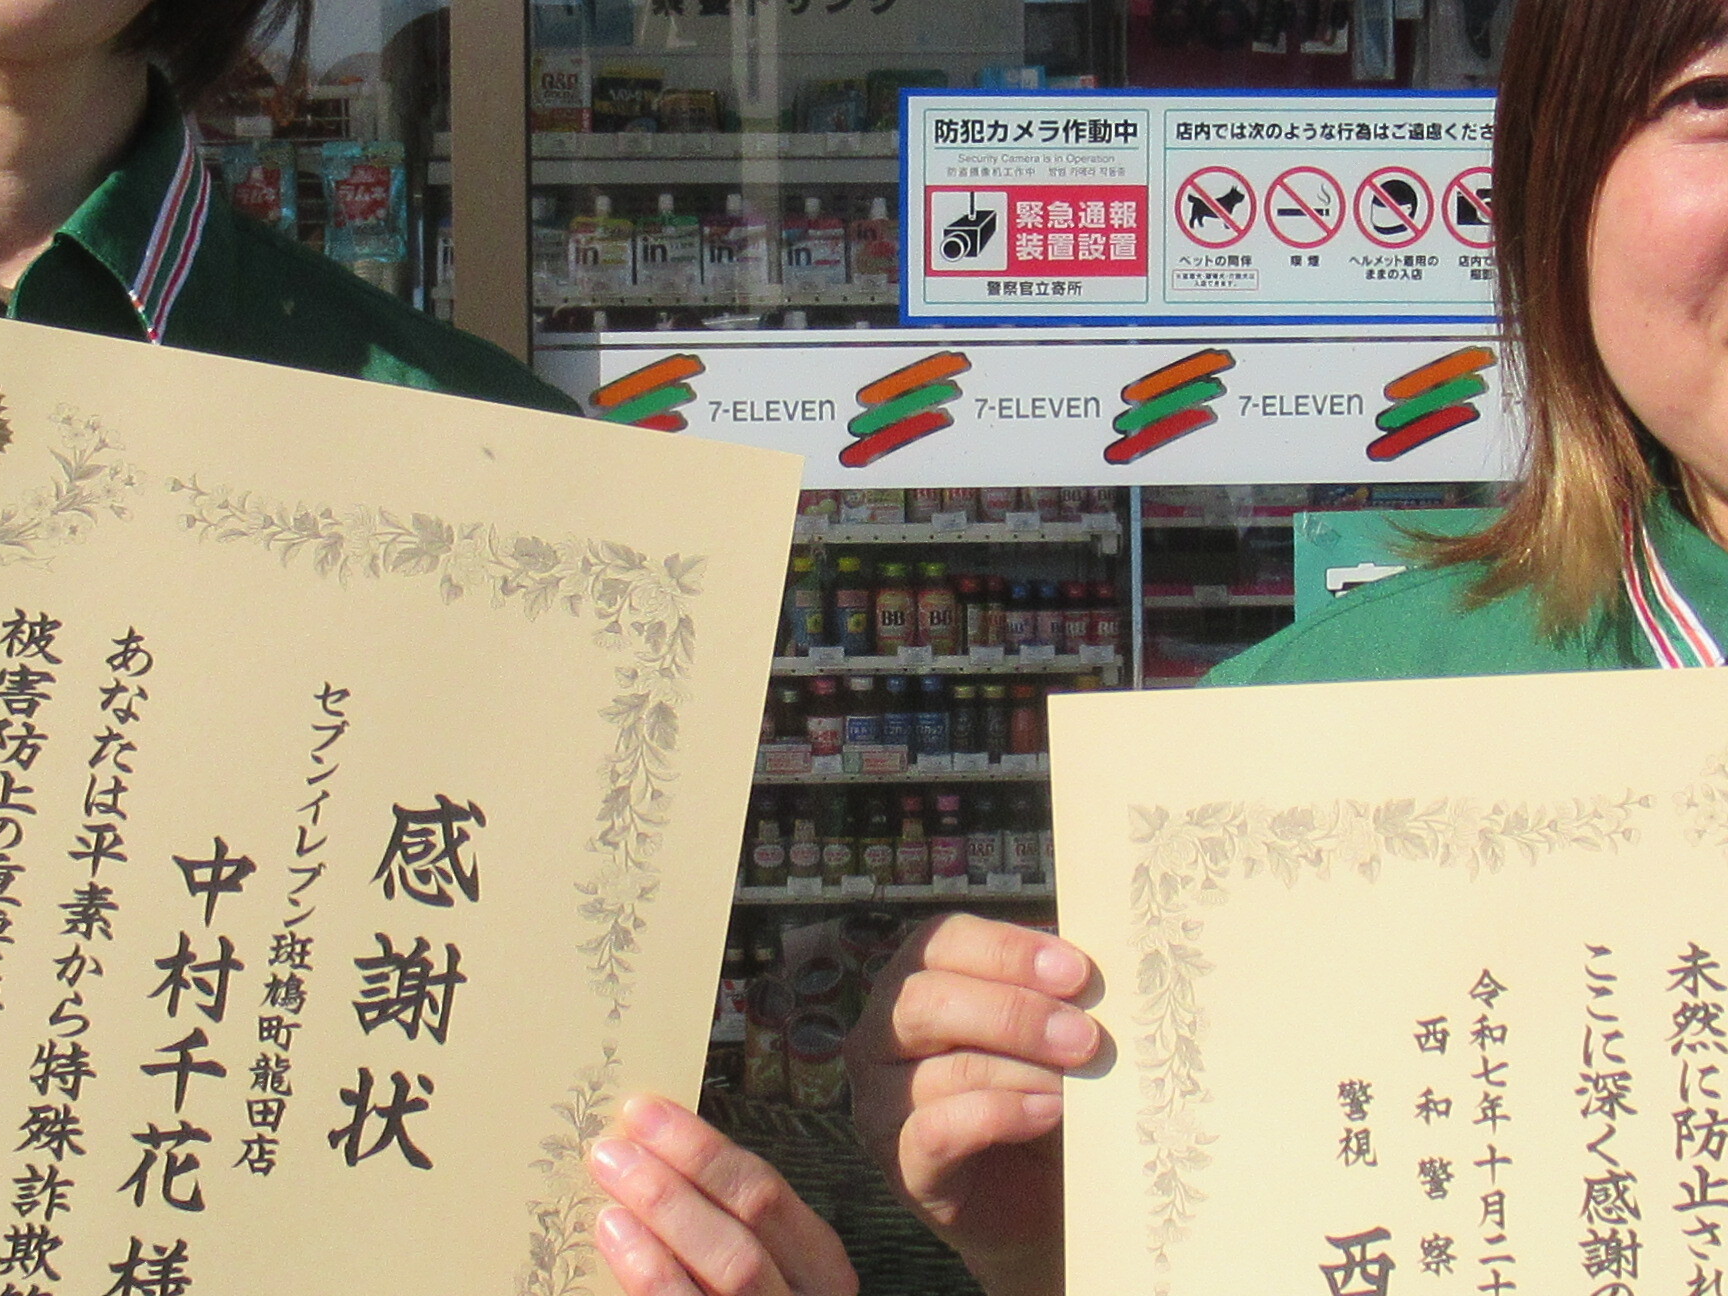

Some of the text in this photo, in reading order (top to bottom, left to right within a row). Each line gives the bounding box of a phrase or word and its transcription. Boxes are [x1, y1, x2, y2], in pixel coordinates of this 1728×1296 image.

[934, 119, 1139, 145] 防犯カメラ作動中
[958, 154, 998, 165] Security
[1001, 154, 1040, 164] Camera
[1066, 154, 1115, 165] Operation
[1015, 200, 1138, 229] 緊急通報
[1015, 233, 1138, 261] 装置設置
[1178, 255, 1253, 267] ペットの同伴
[1349, 255, 1439, 267] ヘルメット着用の
[1365, 269, 1423, 280] ままの入店
[987, 281, 1083, 297] 警察官立寄所
[233, 680, 351, 1177] セブンイレブン斑鳩町龍田店
[328, 793, 486, 1170] 感謝状
[1335, 1077, 1378, 1168] 警視
